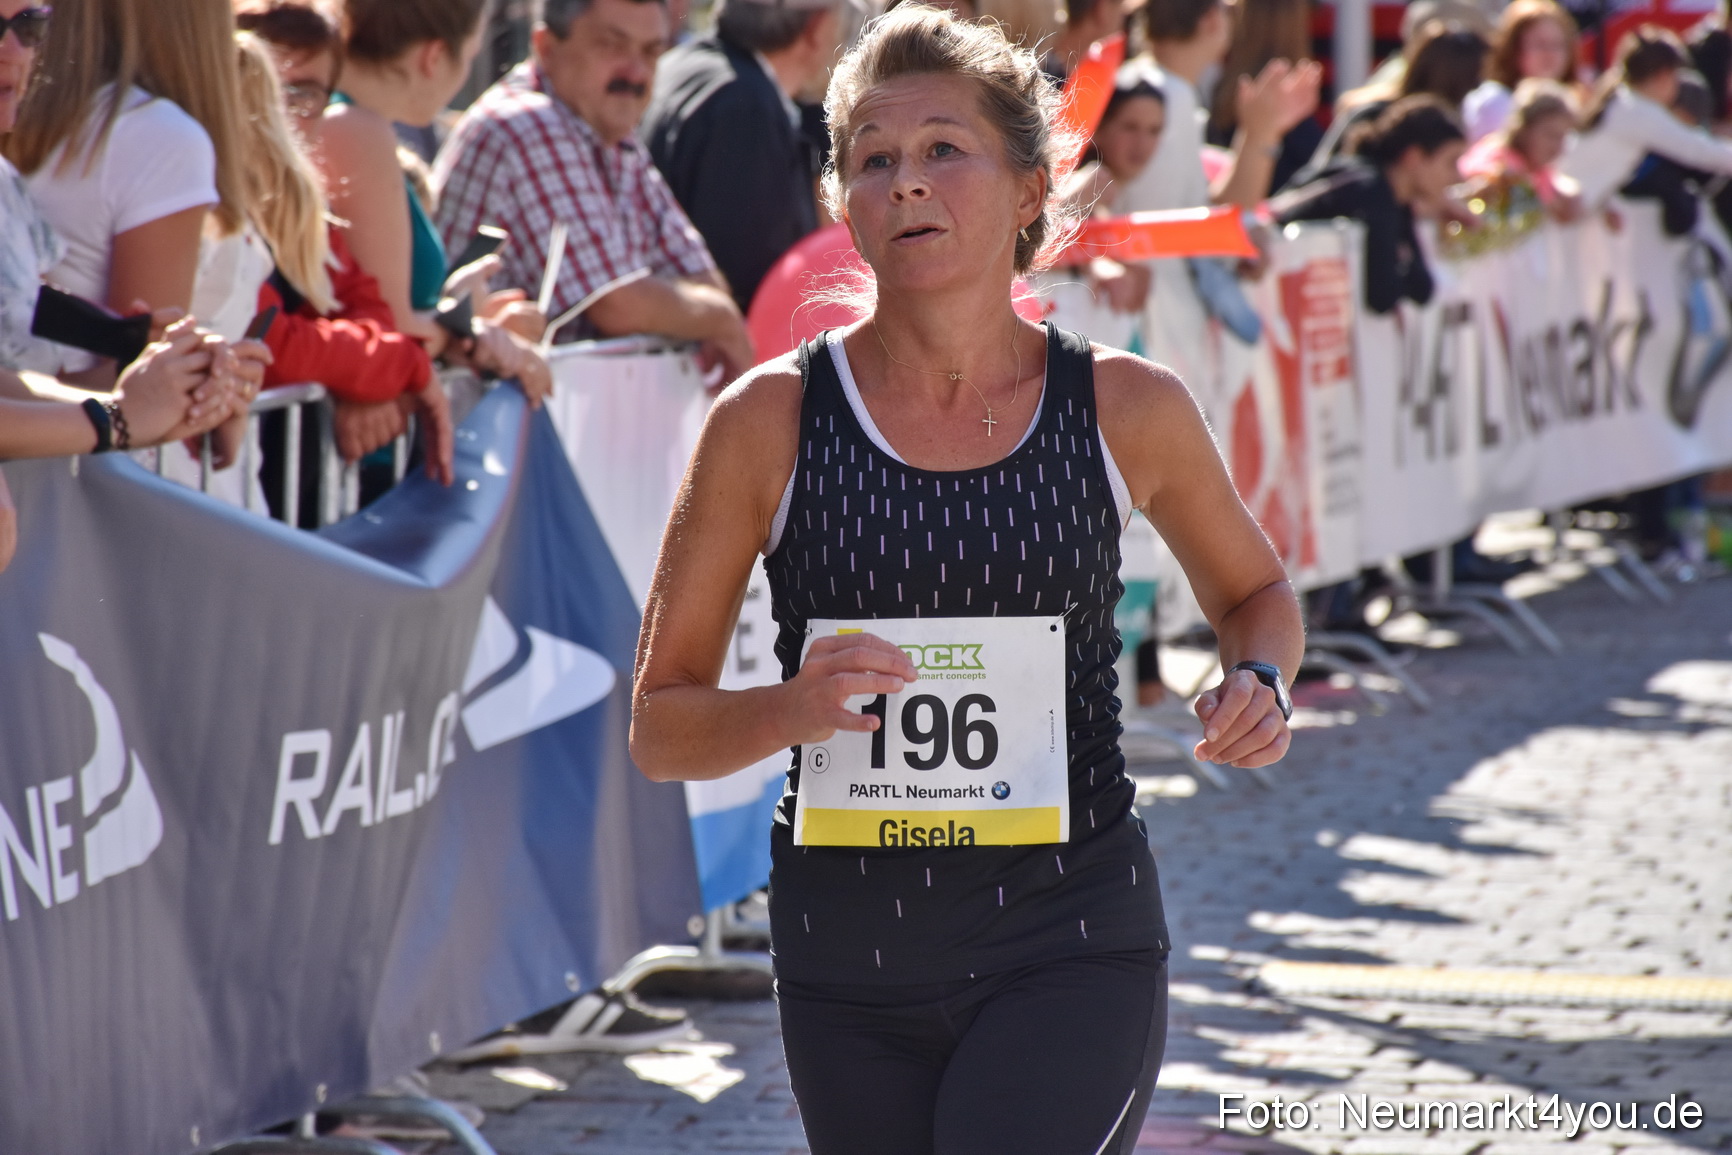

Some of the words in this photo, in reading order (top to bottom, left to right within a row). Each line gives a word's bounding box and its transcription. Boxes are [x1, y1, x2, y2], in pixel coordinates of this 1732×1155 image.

[918, 672, 944, 680] smart
[946, 672, 987, 681] concepts
[861, 693, 999, 771] 196
[815, 753, 823, 767] C
[849, 784, 902, 798] PARTL
[906, 784, 985, 799] Neumarkt
[879, 819, 975, 847] Gisela
